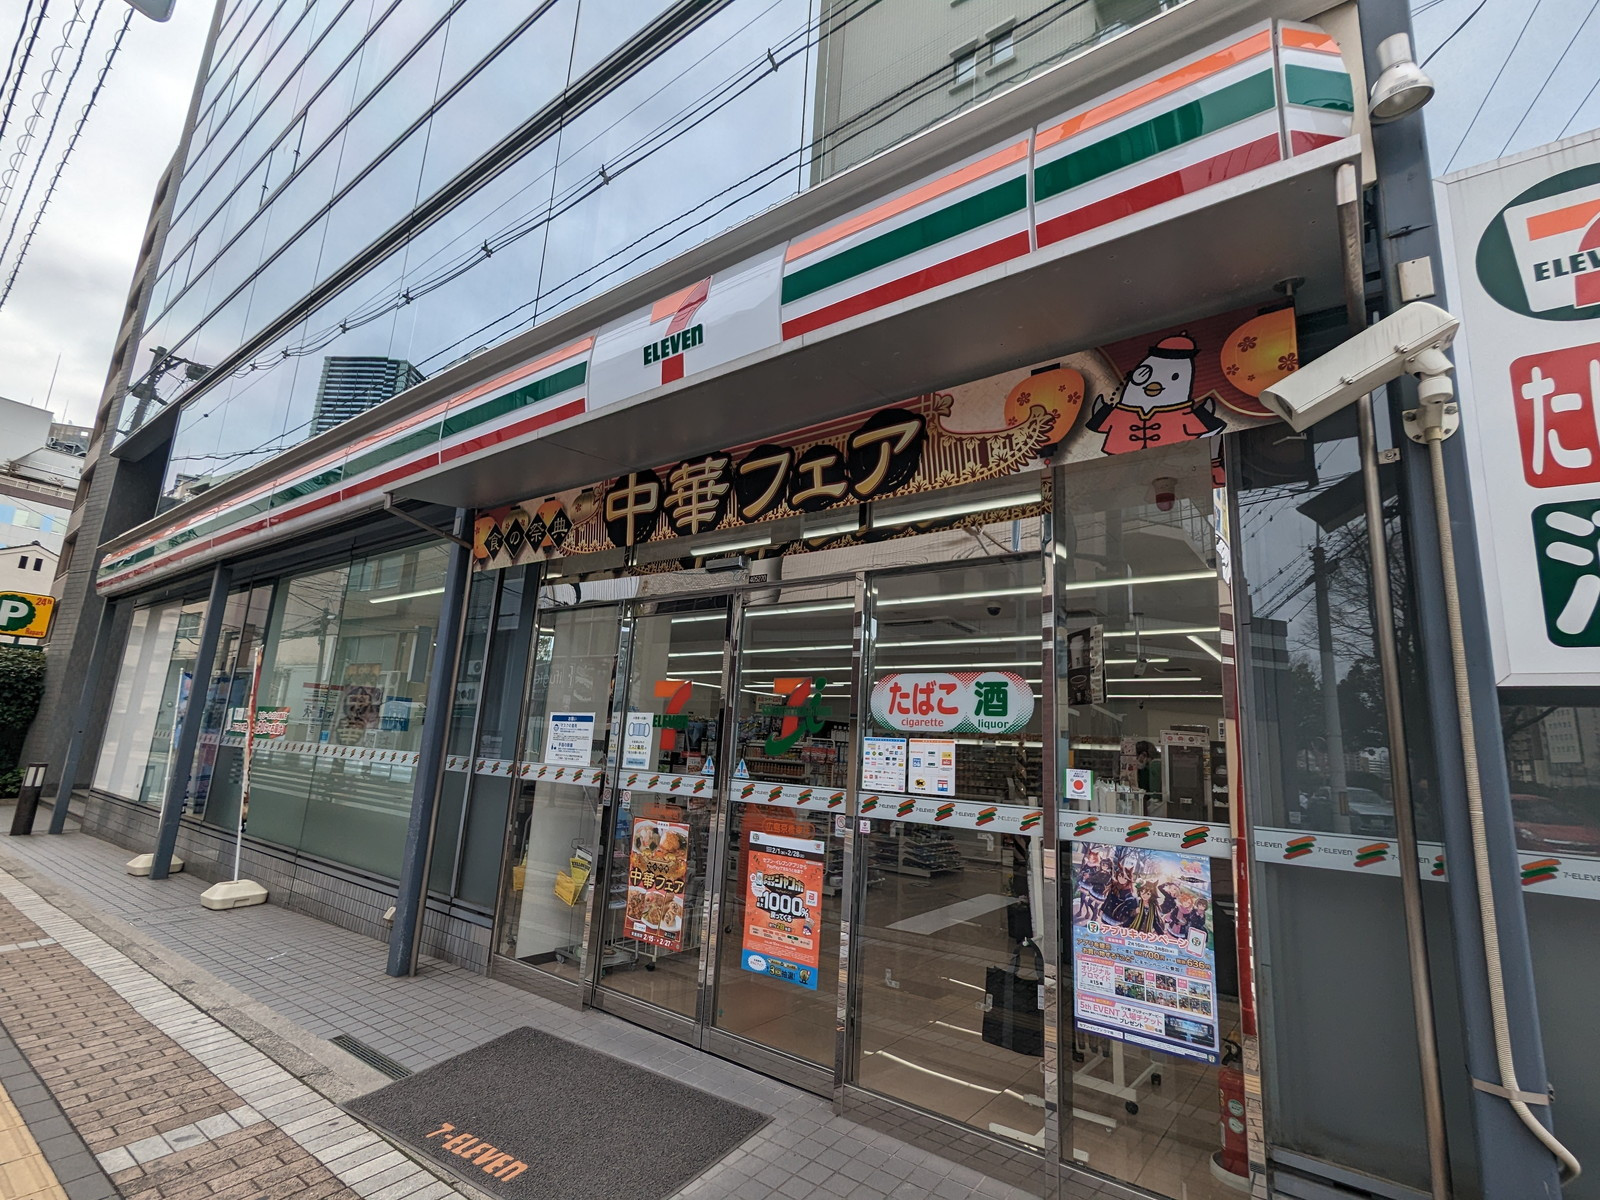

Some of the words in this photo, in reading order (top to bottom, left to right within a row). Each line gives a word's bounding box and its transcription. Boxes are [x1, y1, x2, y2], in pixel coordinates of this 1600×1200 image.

[604, 419, 922, 546] 中華フェア
[487, 516, 568, 552] 食の祭典
[0, 599, 29, 627] P
[888, 679, 959, 716] たばこ
[974, 681, 1009, 717] 酒
[901, 717, 944, 729] cigarette
[977, 718, 1010, 730] liquor
[630, 867, 685, 894] 中華フェア
[1100, 924, 1188, 948] アプリキャンペーン
[1093, 1004, 1120, 1017] EVENT
